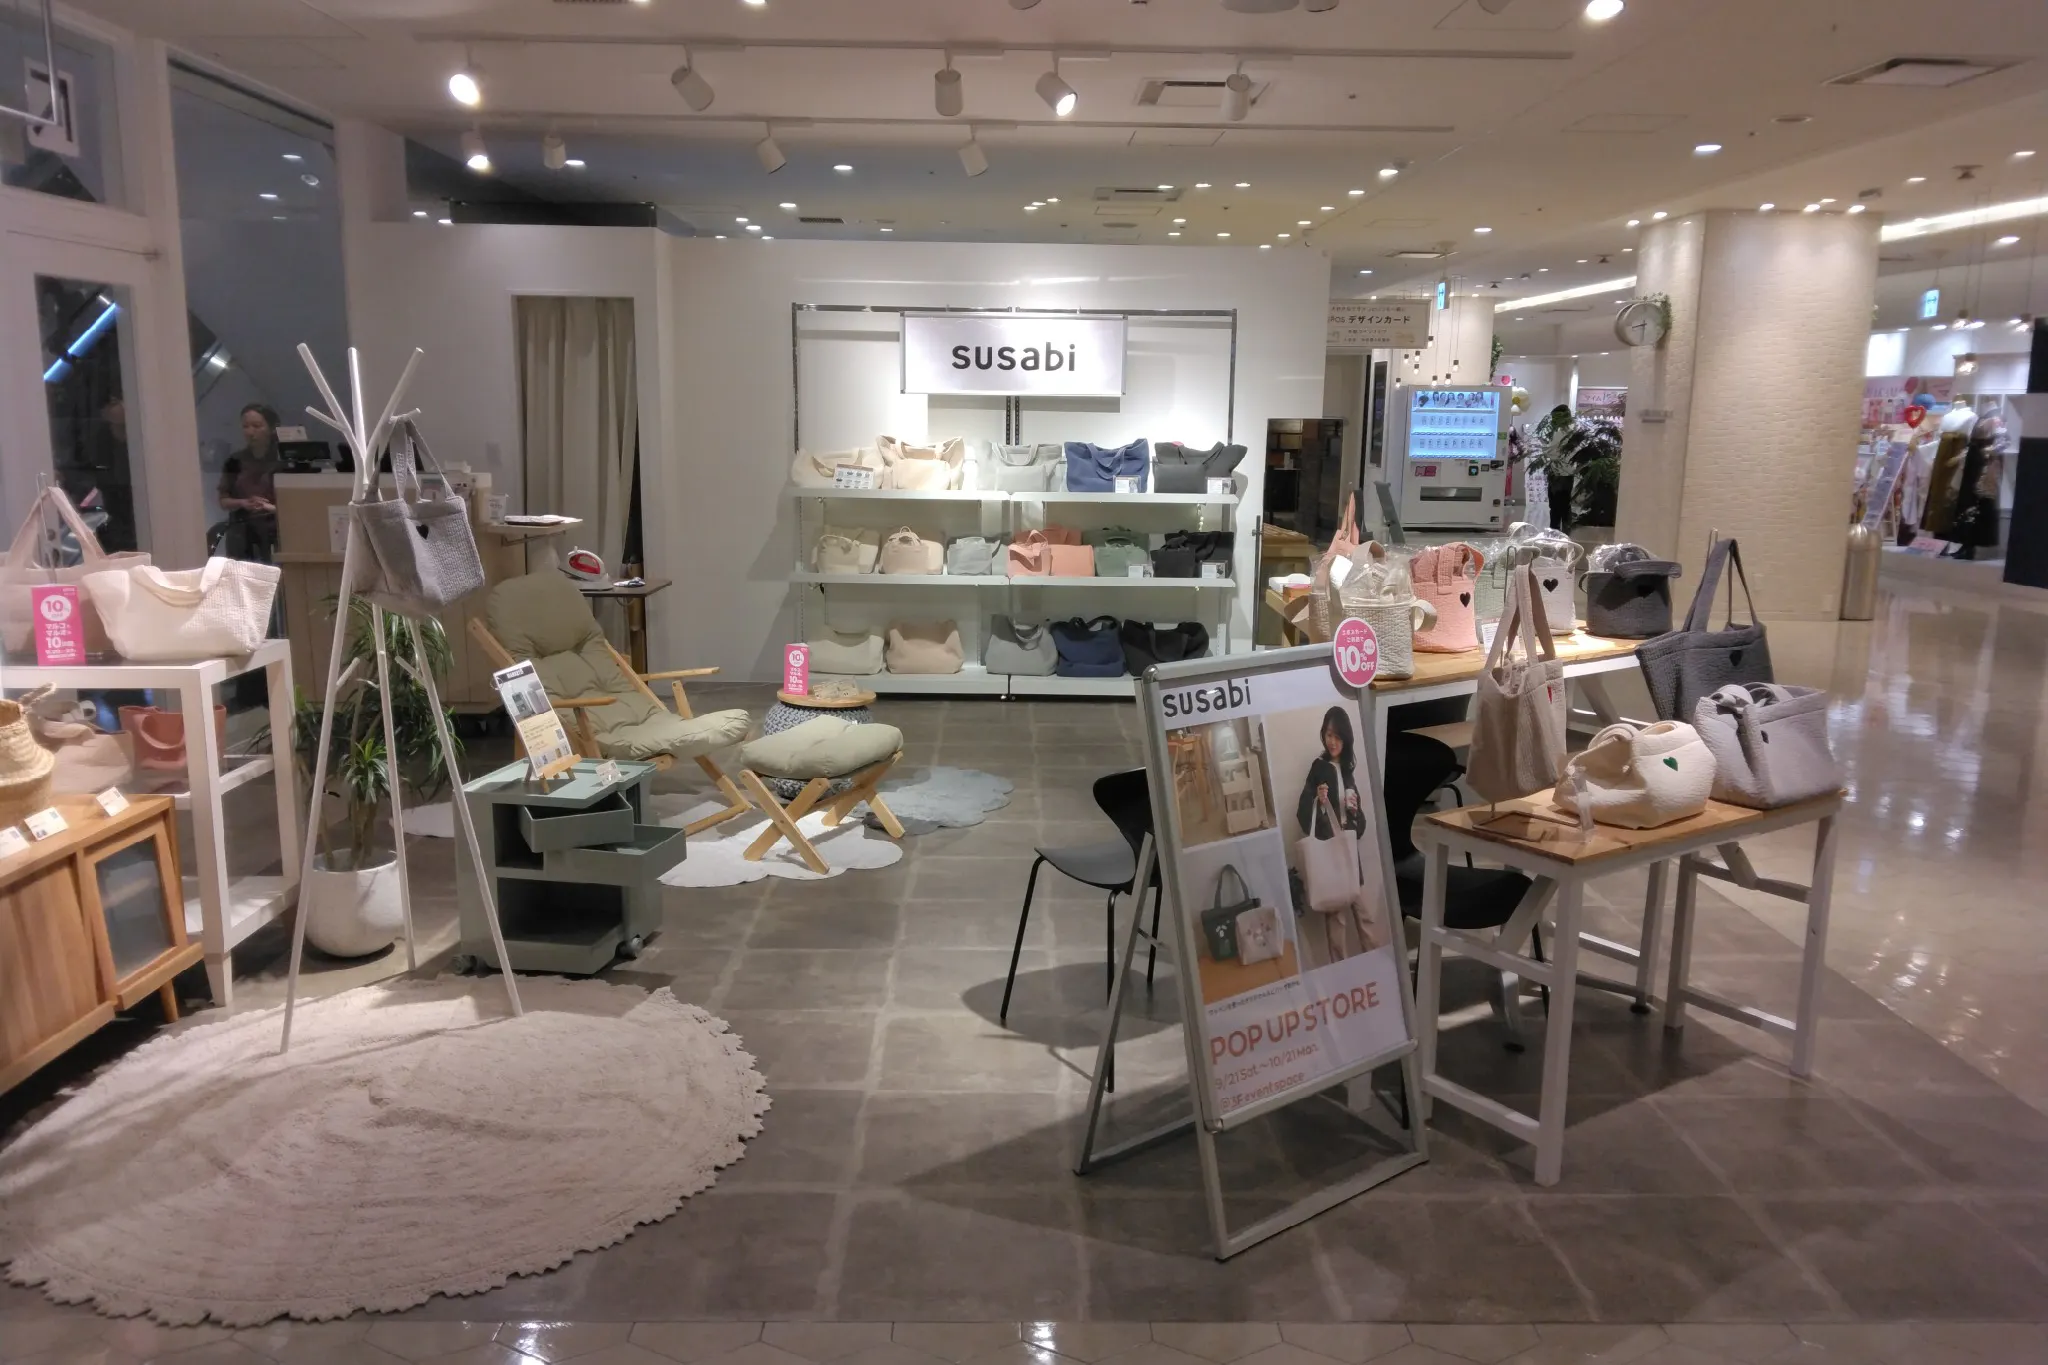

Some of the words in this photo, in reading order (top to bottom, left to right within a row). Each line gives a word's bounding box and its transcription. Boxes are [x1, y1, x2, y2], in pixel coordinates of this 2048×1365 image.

[1348, 315, 1411, 324] デザインカード
[952, 341, 1075, 371] susabi
[1360, 661, 1375, 671] OFF
[1162, 678, 1251, 717] susabi
[1210, 1024, 1263, 1065] POP
[1266, 1010, 1300, 1042] UP
[1303, 981, 1380, 1031] STORE
